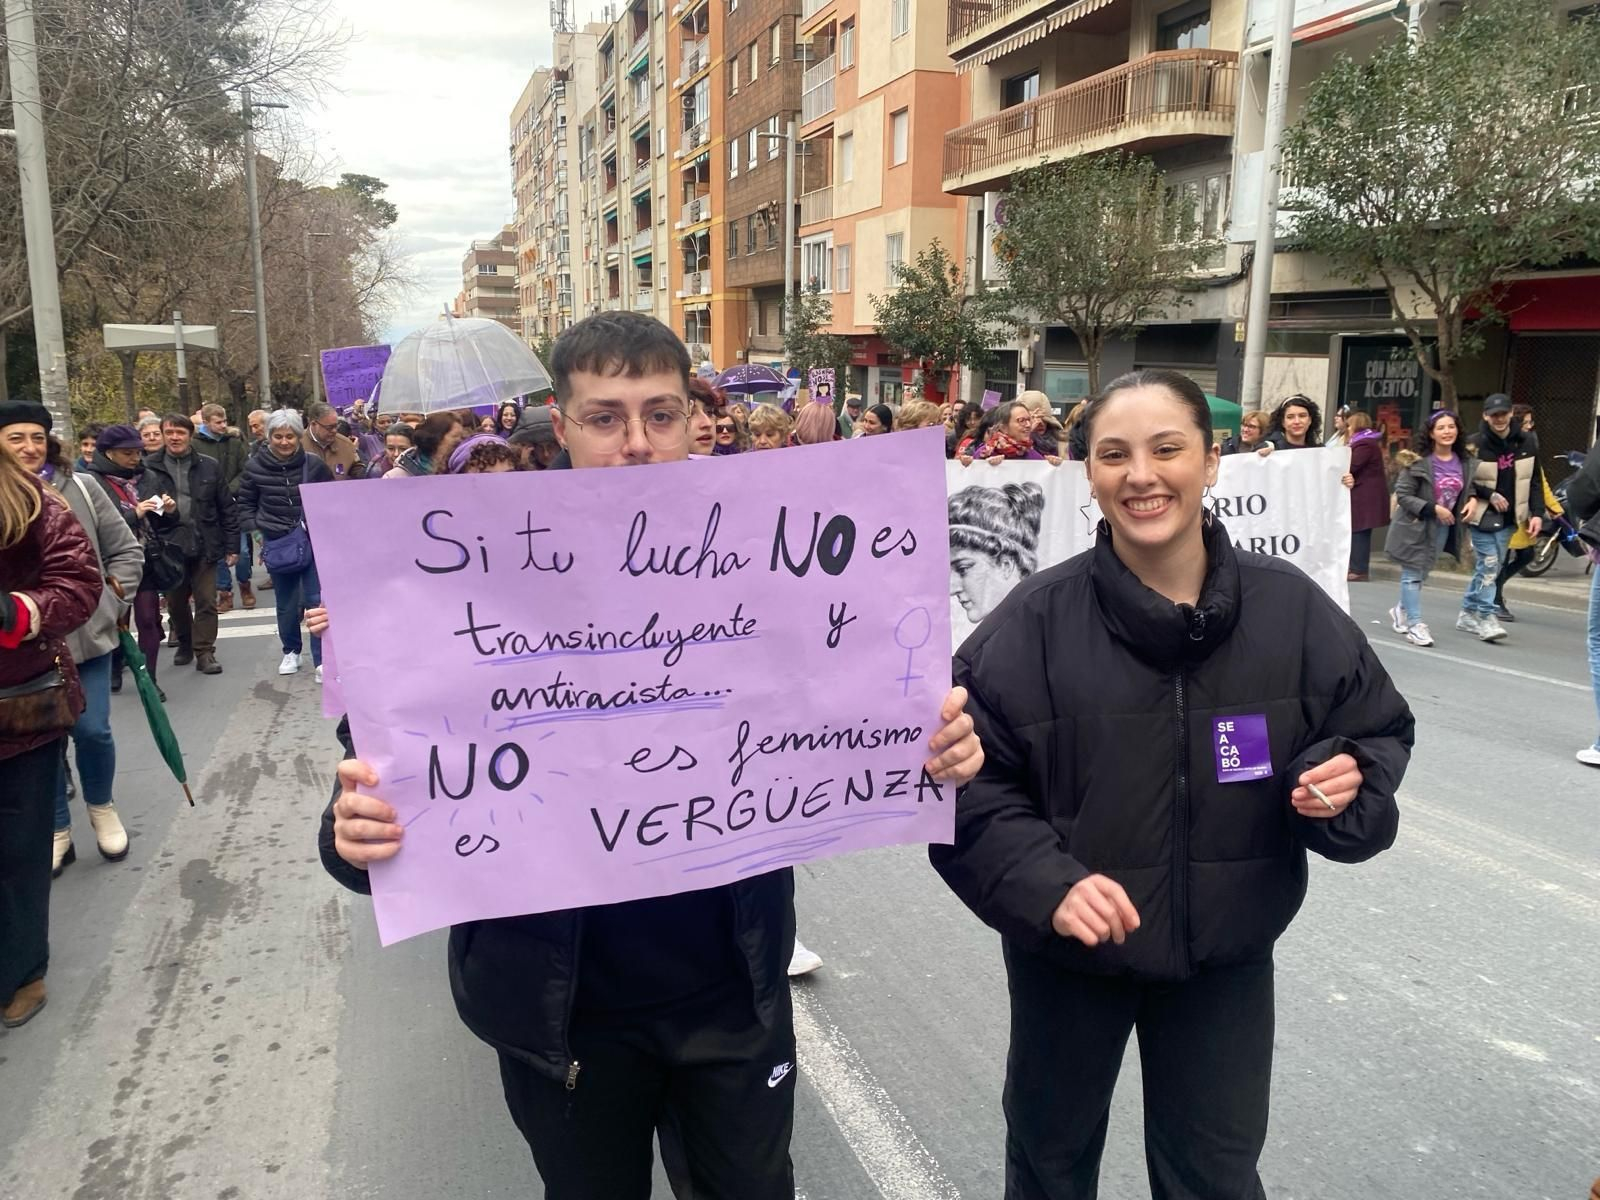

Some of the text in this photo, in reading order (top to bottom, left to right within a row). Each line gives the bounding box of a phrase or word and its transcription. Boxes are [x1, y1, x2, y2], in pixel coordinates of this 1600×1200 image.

[415, 502, 918, 579] Si tu lucha NO es
[454, 601, 857, 668] transincluyente y
[491, 671, 733, 711] antiracista...
[1217, 721, 1234, 732] SE
[1219, 733, 1229, 744] A
[429, 719, 923, 801] NO es feminismo
[1220, 745, 1240, 756] CA
[1221, 754, 1241, 768] BÓ
[455, 763, 944, 858] es VERGÜENZA
